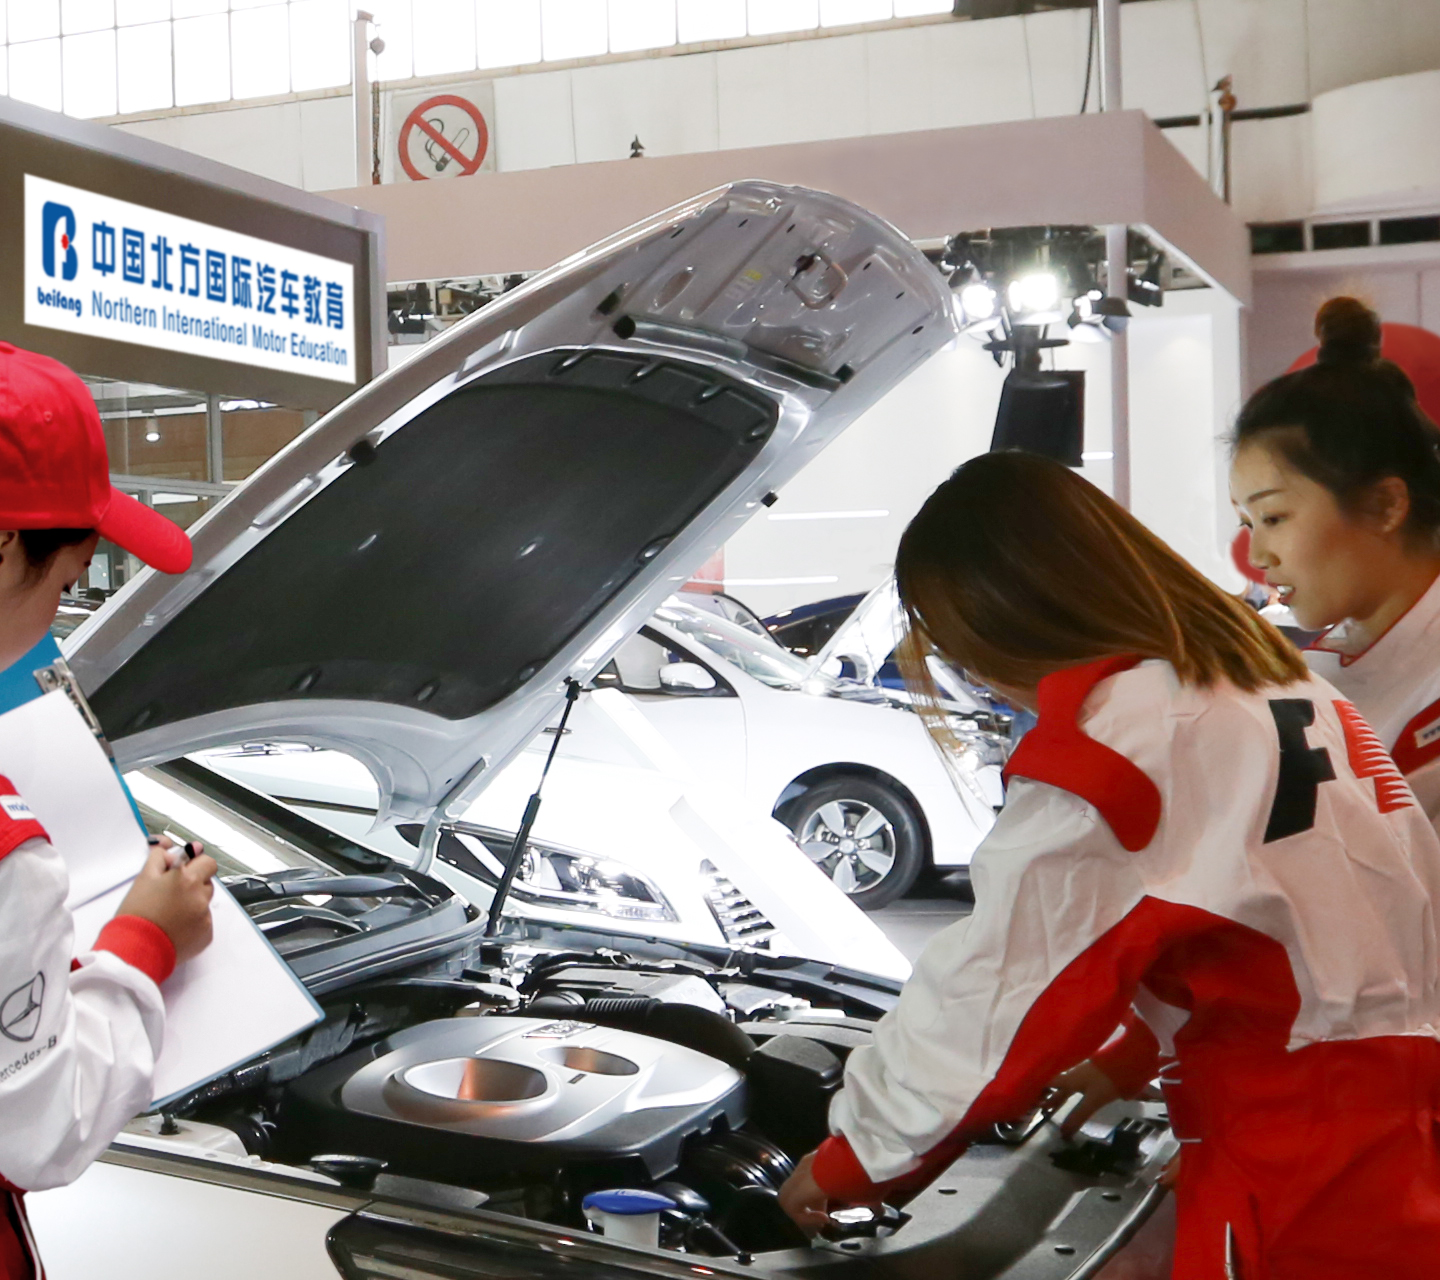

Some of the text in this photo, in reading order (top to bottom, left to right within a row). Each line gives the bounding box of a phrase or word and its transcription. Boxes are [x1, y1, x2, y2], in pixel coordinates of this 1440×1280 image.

[37, 286, 82, 317] beifang
[91, 221, 345, 330] 中国北方国际汽车教育
[91, 290, 348, 366] Northern International Motor Education
